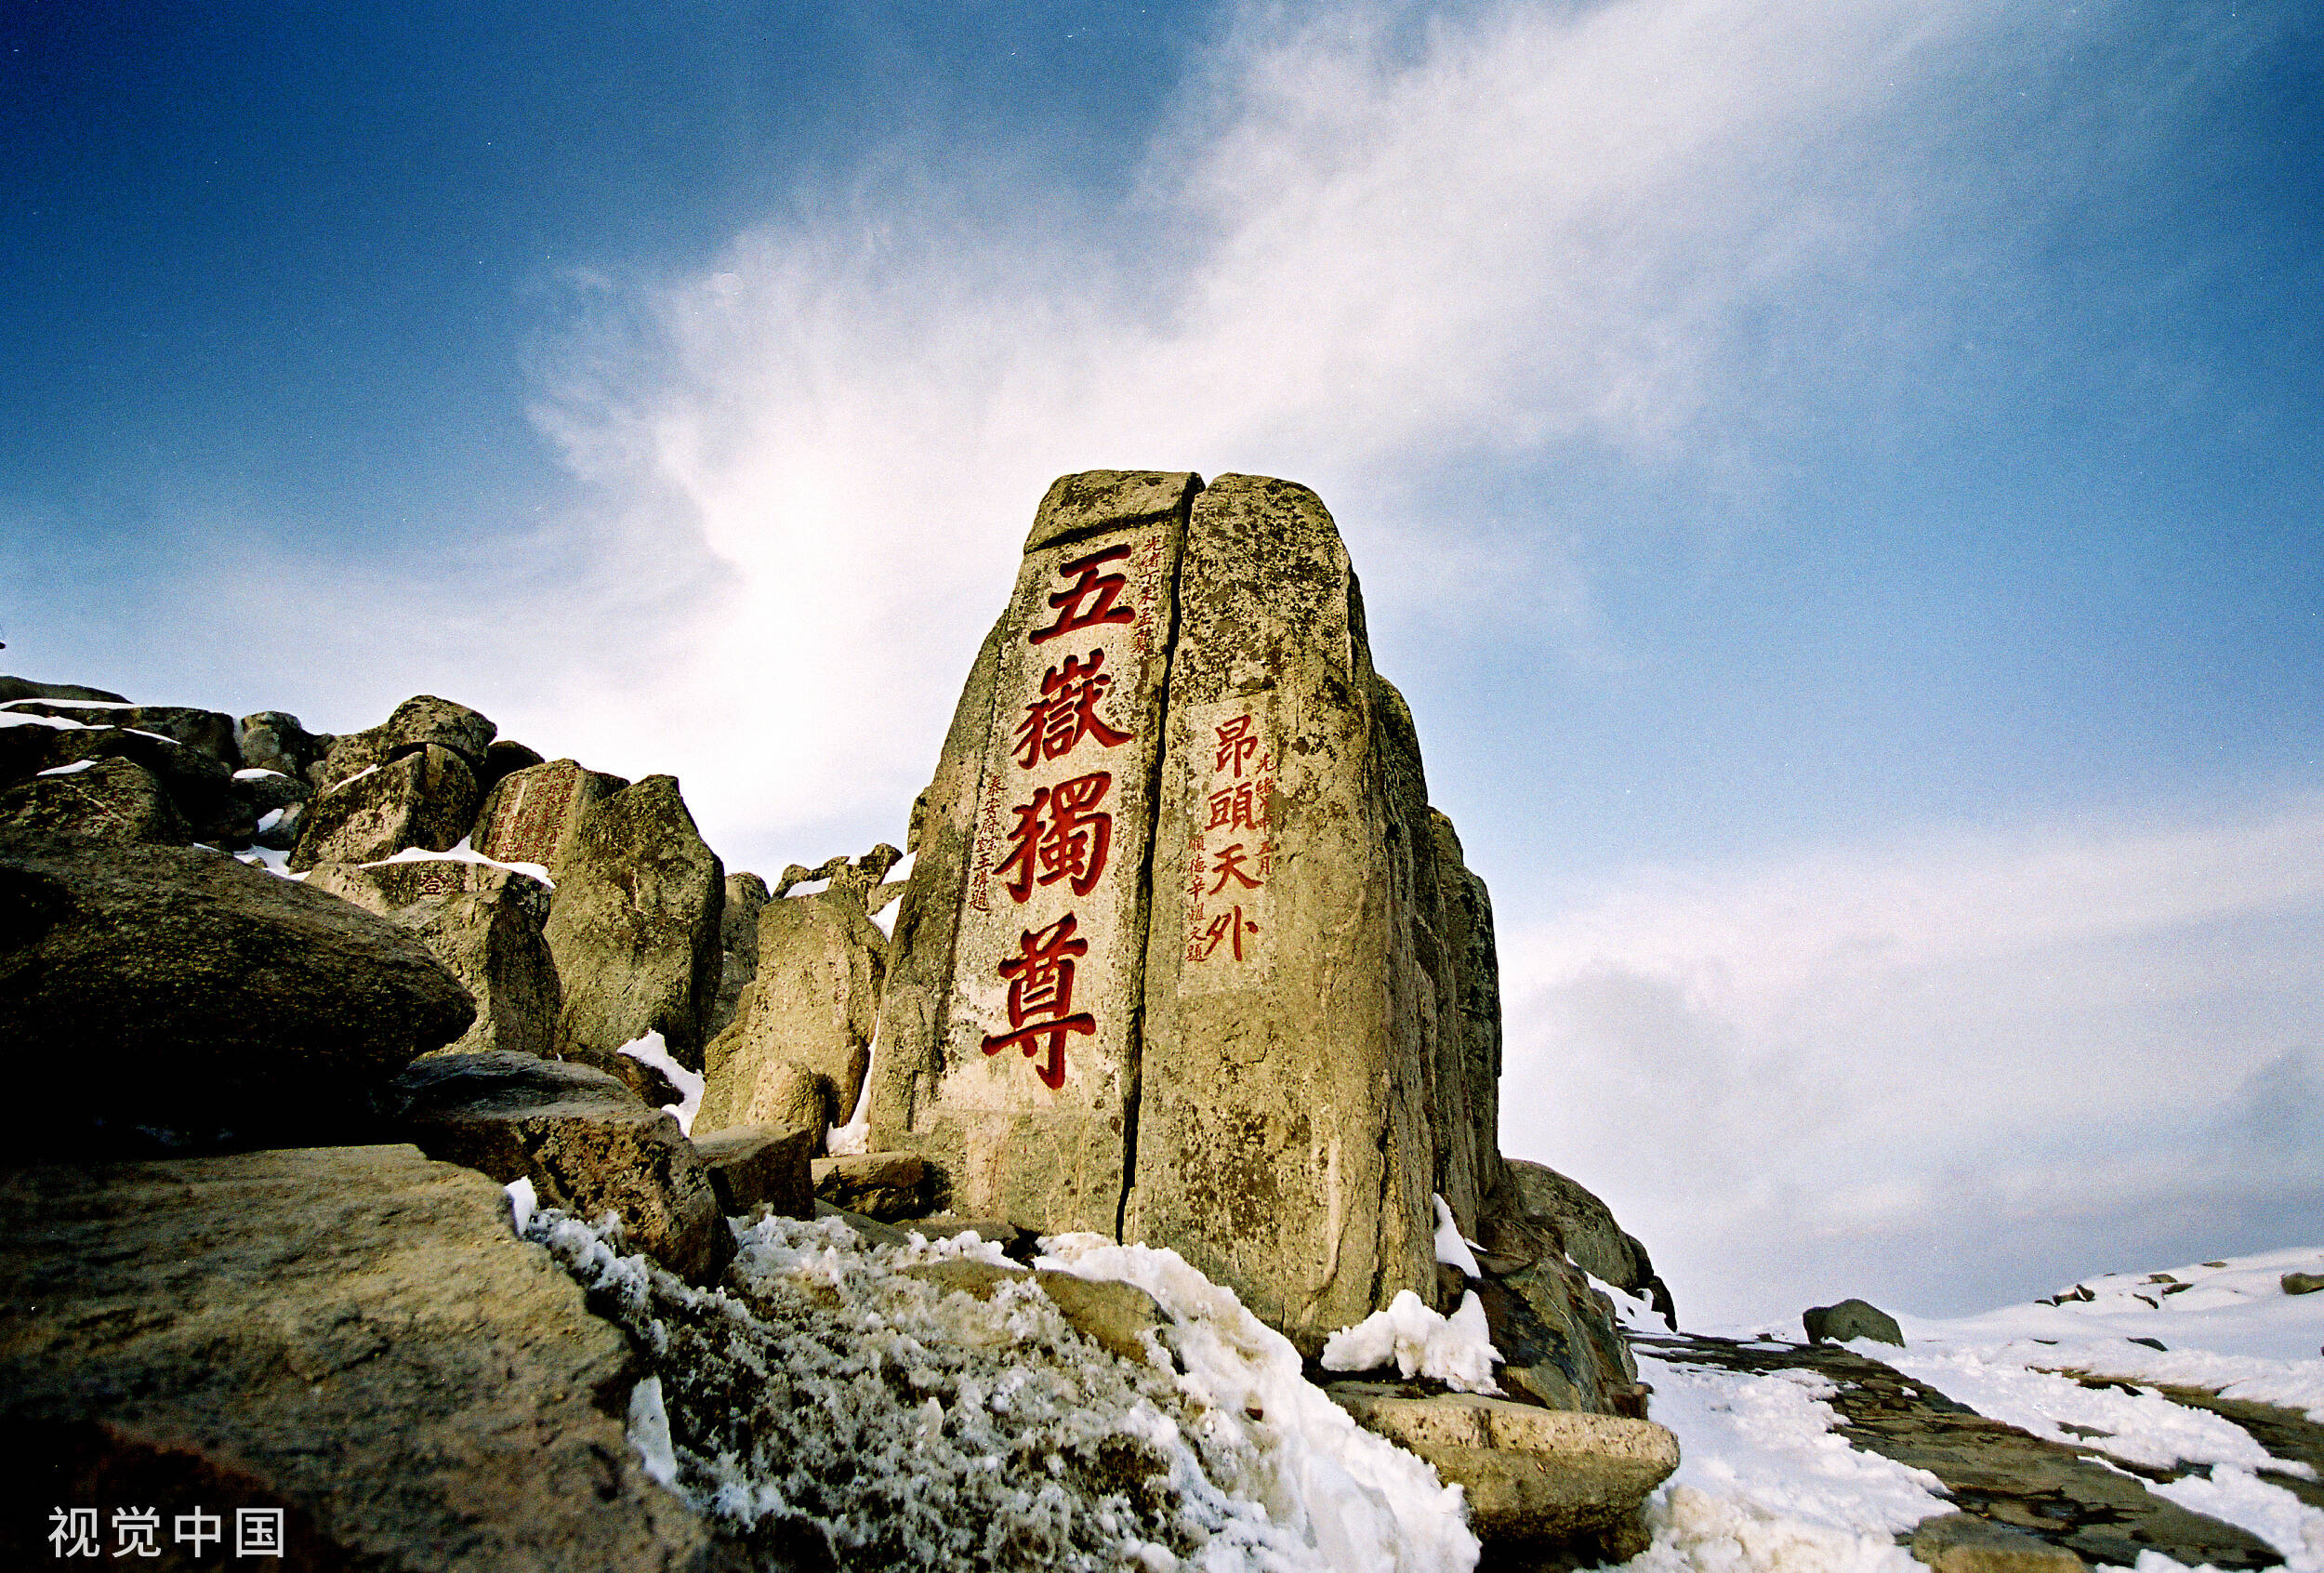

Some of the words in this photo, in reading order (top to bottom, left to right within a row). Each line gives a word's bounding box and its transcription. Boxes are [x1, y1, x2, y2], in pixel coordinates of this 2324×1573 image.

[981, 543, 1136, 1090] 五嶽獨尊
[1206, 714, 1264, 963] 昂頭天外
